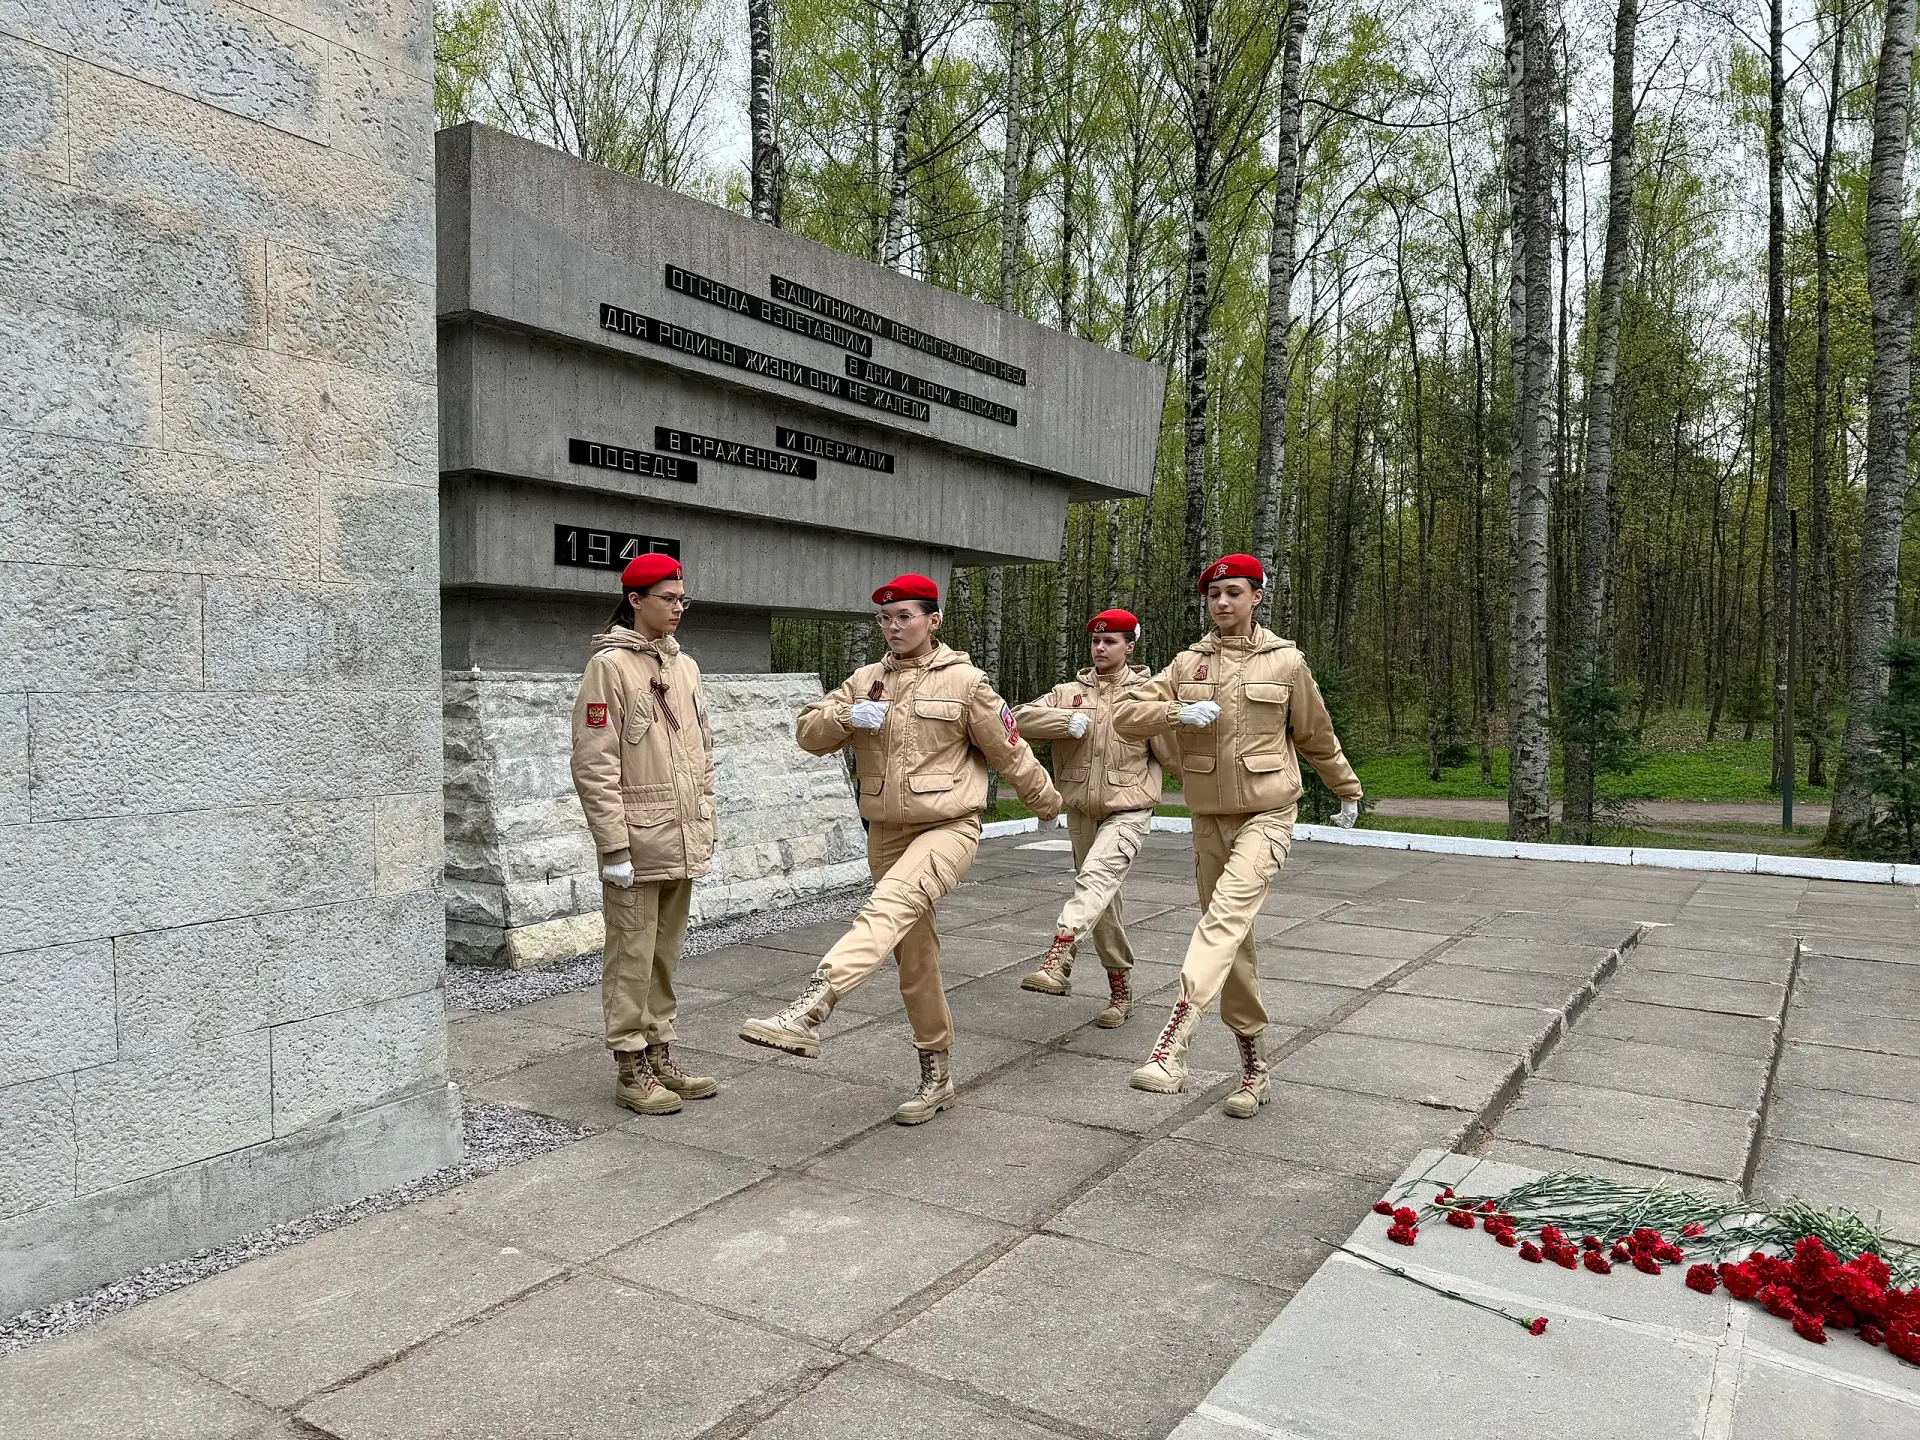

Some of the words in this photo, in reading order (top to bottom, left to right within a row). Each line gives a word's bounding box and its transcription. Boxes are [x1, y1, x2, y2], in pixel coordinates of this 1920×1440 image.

[672, 269, 751, 314] ОТСЮДА
[761, 301, 868, 354] ВЗЛЕТАВШИМ
[777, 280, 882, 333] ЗАЩИТНИКАМ
[890, 323, 997, 375] ЛЕНИНГРАДСКОГО
[1000, 363, 1025, 385] НЕБА
[605, 308, 648, 338] ДЛЯ
[659, 323, 736, 365] РОДИНЫ
[745, 350, 803, 384] ЖИЗНИ
[810, 370, 840, 395] ОНИ
[849, 382, 868, 402] НЕ
[874, 389, 927, 420] ЖАЛЕЛИ
[849, 358, 858, 375] В
[864, 363, 892, 386] ДНИ
[901, 374, 909, 392] И
[918, 380, 951, 404] НОЧИ
[958, 393, 1012, 424] БЛОКАДЫ
[589, 444, 678, 478] ПОБЕДУ
[669, 432, 681, 451] В
[690, 436, 799, 475] СРАЖЕНЬЯХ
[786, 430, 796, 449] И
[804, 435, 886, 470] ОДЕРЖАЛИ
